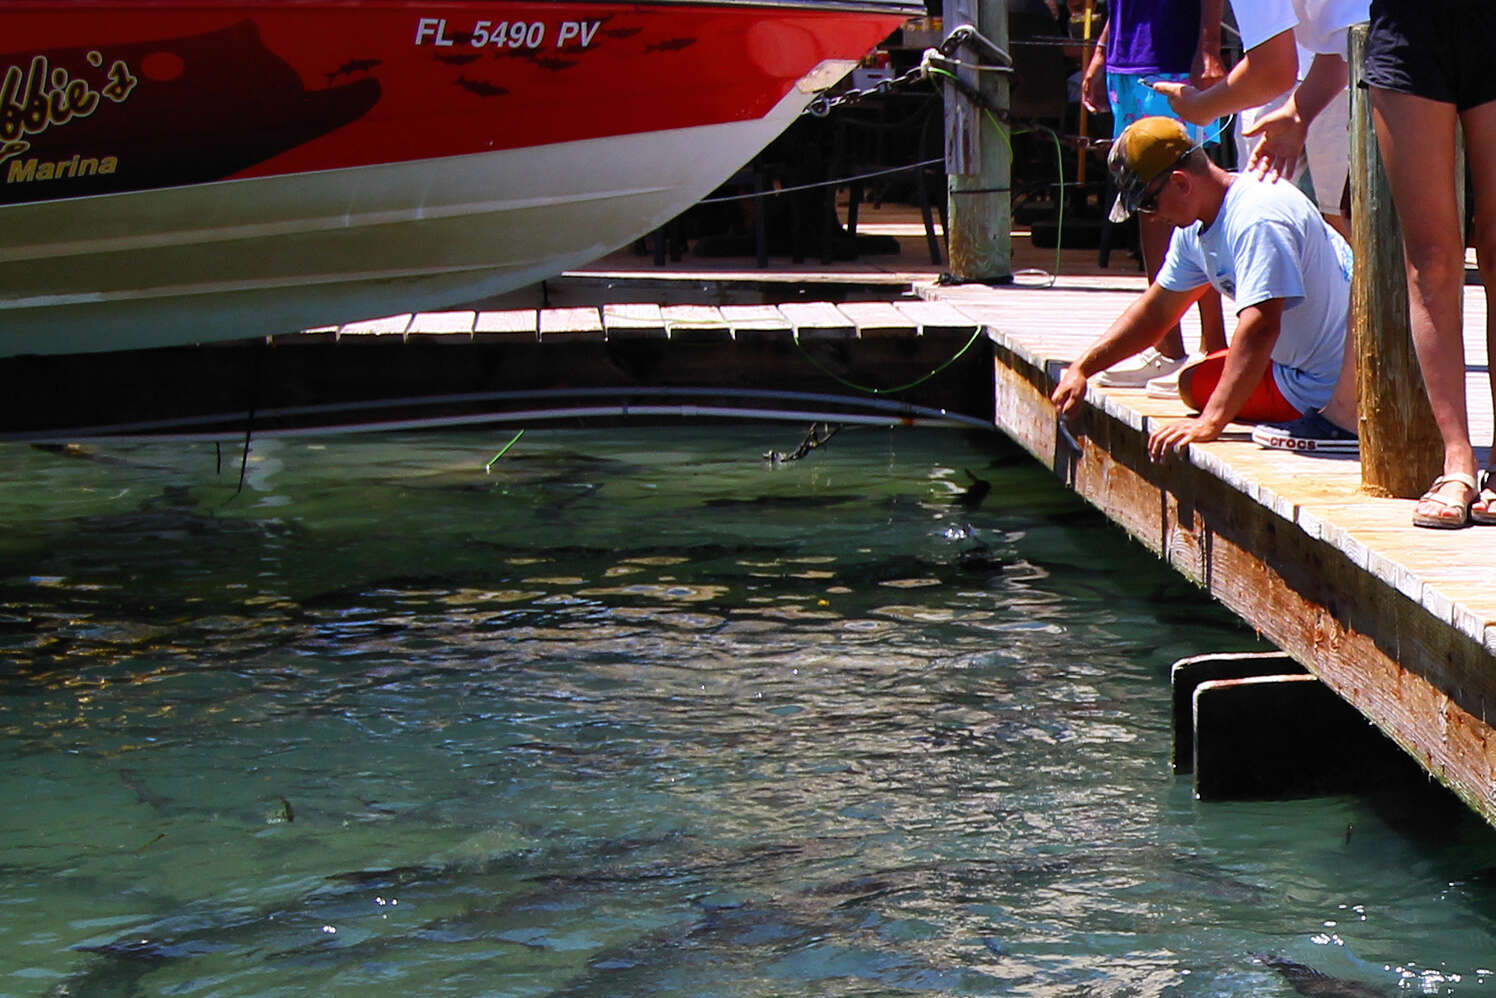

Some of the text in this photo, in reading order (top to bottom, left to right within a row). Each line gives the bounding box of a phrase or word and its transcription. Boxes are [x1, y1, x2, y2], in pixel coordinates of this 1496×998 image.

[415, 18, 600, 48] FL 5490 PV
[7, 154, 118, 183] Marina
[1270, 437, 1316, 450] crocs
